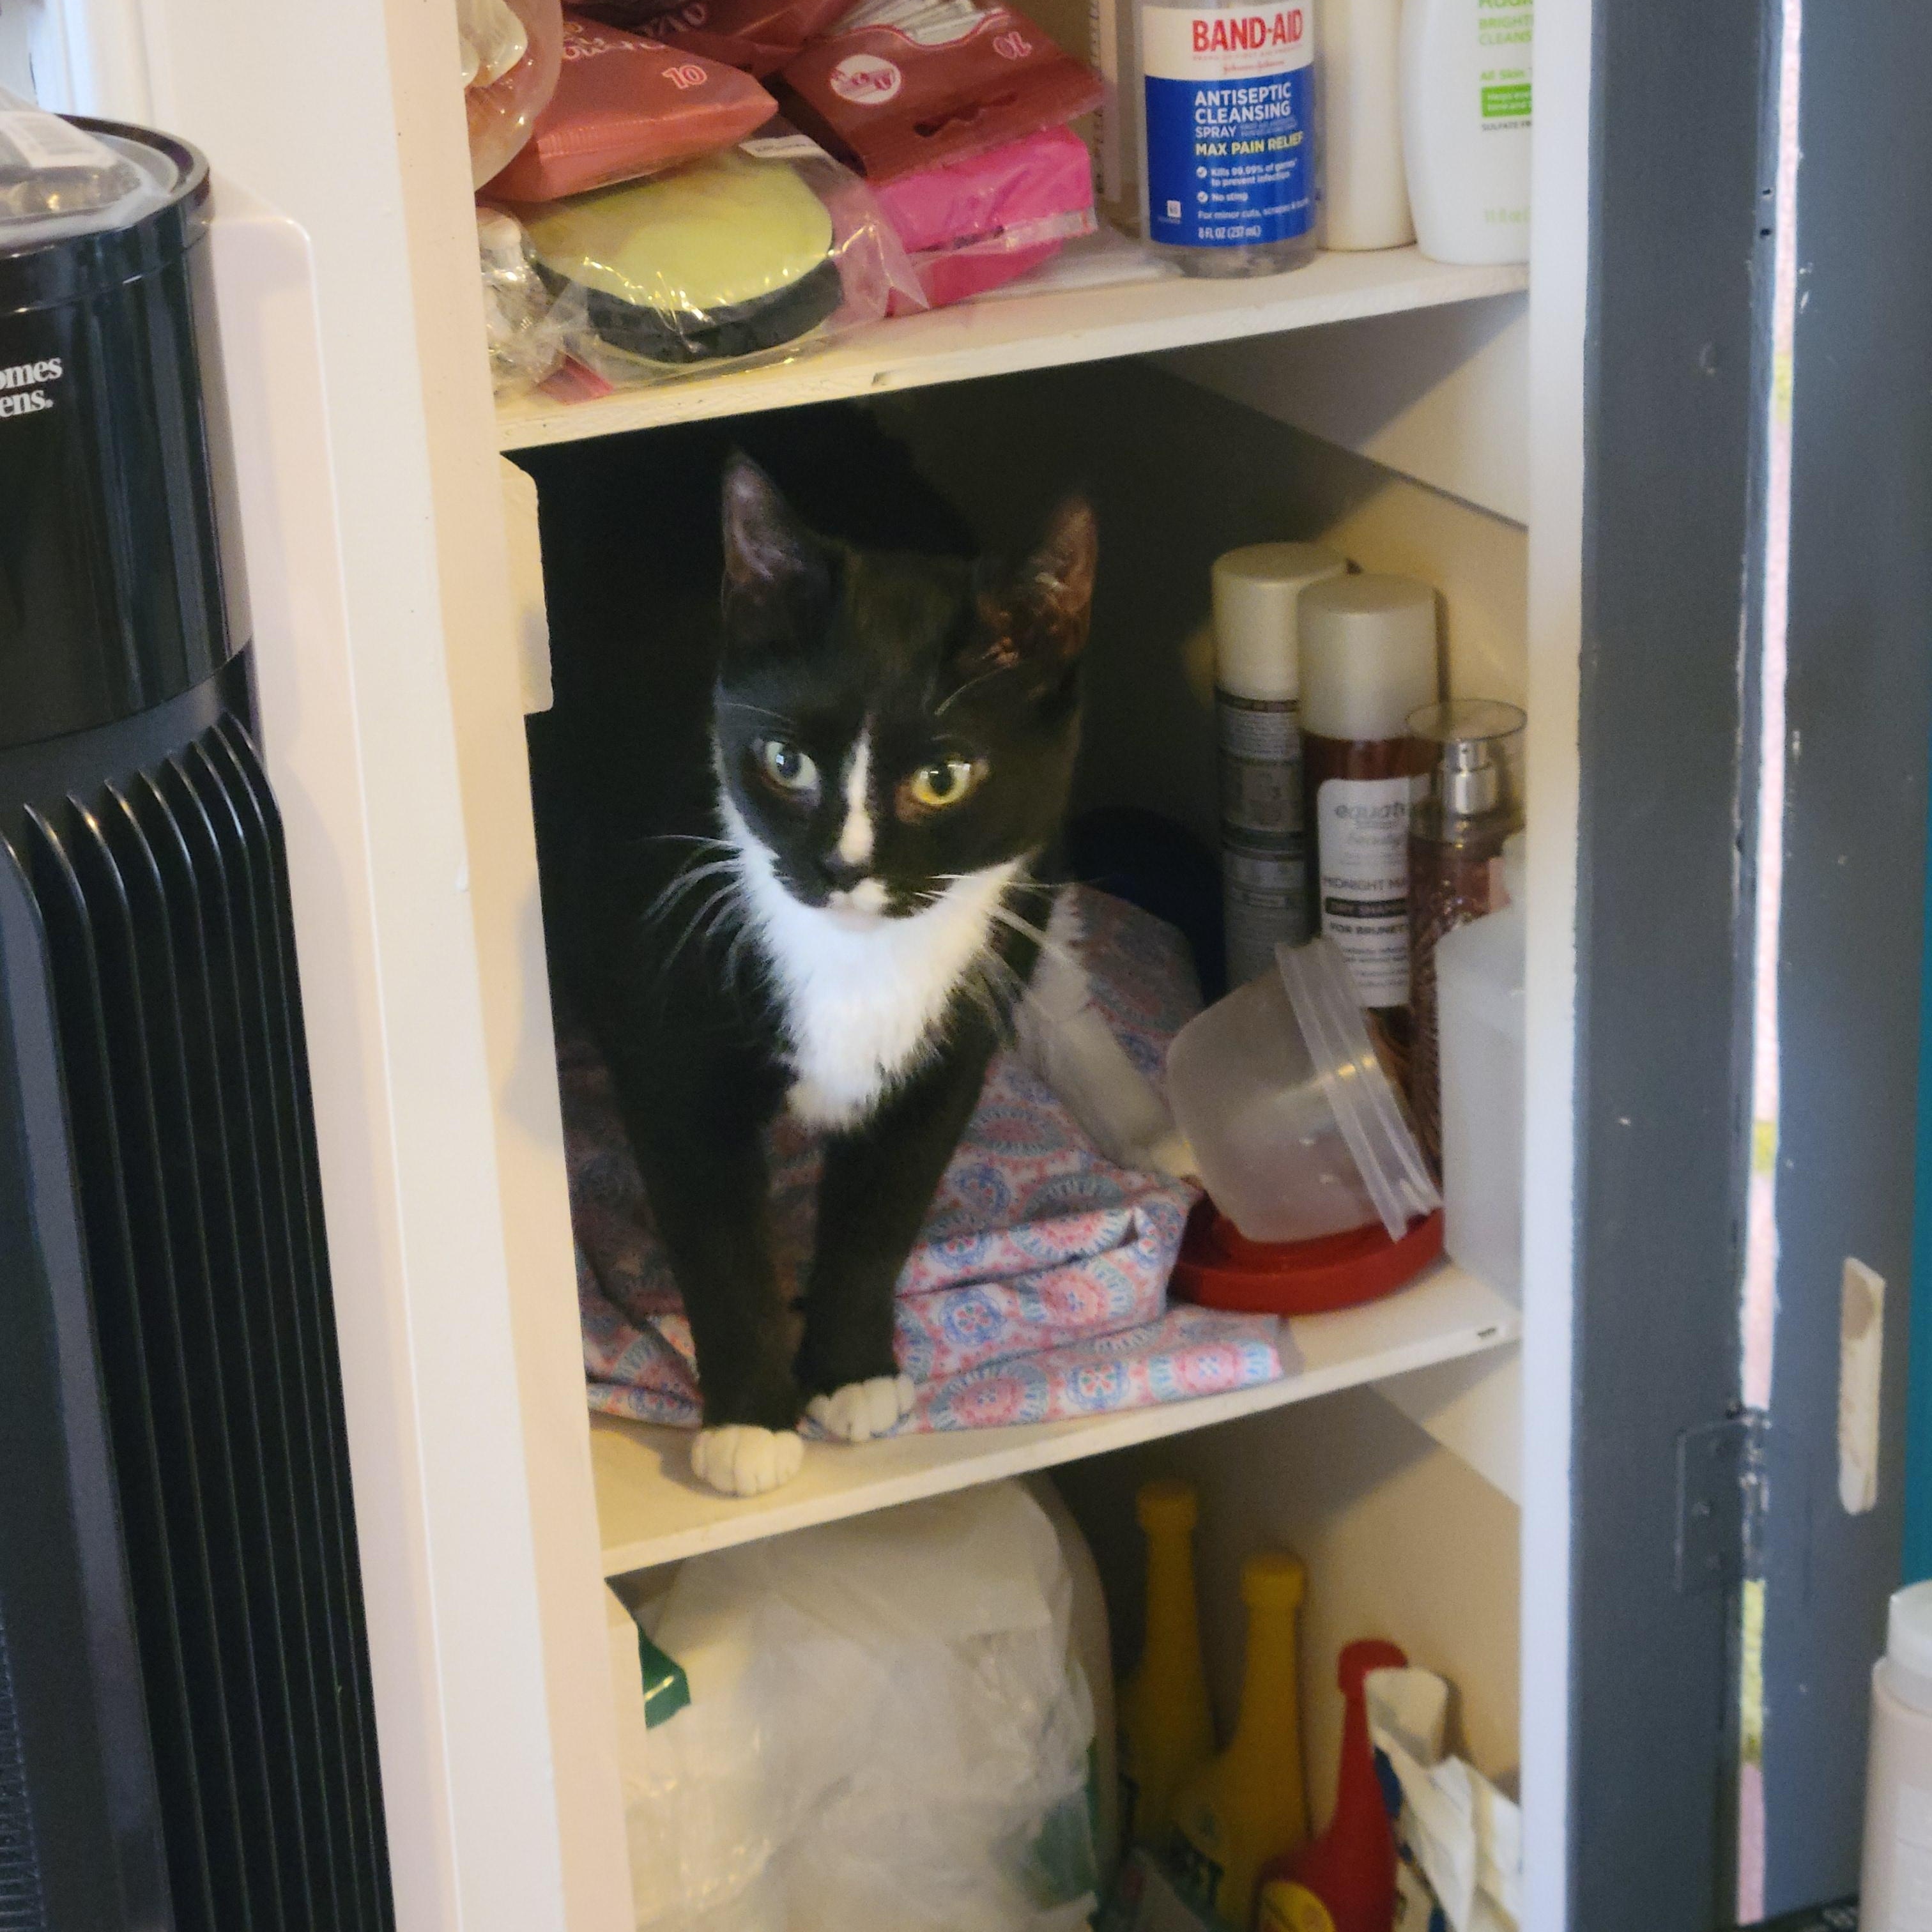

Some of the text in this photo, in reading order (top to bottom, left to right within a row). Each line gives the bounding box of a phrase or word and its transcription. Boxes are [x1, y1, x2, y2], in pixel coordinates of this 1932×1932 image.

[1192, 9, 1303, 52] BAND-AID
[662, 65, 708, 89] 10
[1195, 82, 1291, 106] ANTISEPTIC
[1195, 100, 1291, 124] CLEANSING
[1195, 126, 1237, 138] SPRAY
[1195, 130, 1304, 156] MAX PAIN RELIEF
